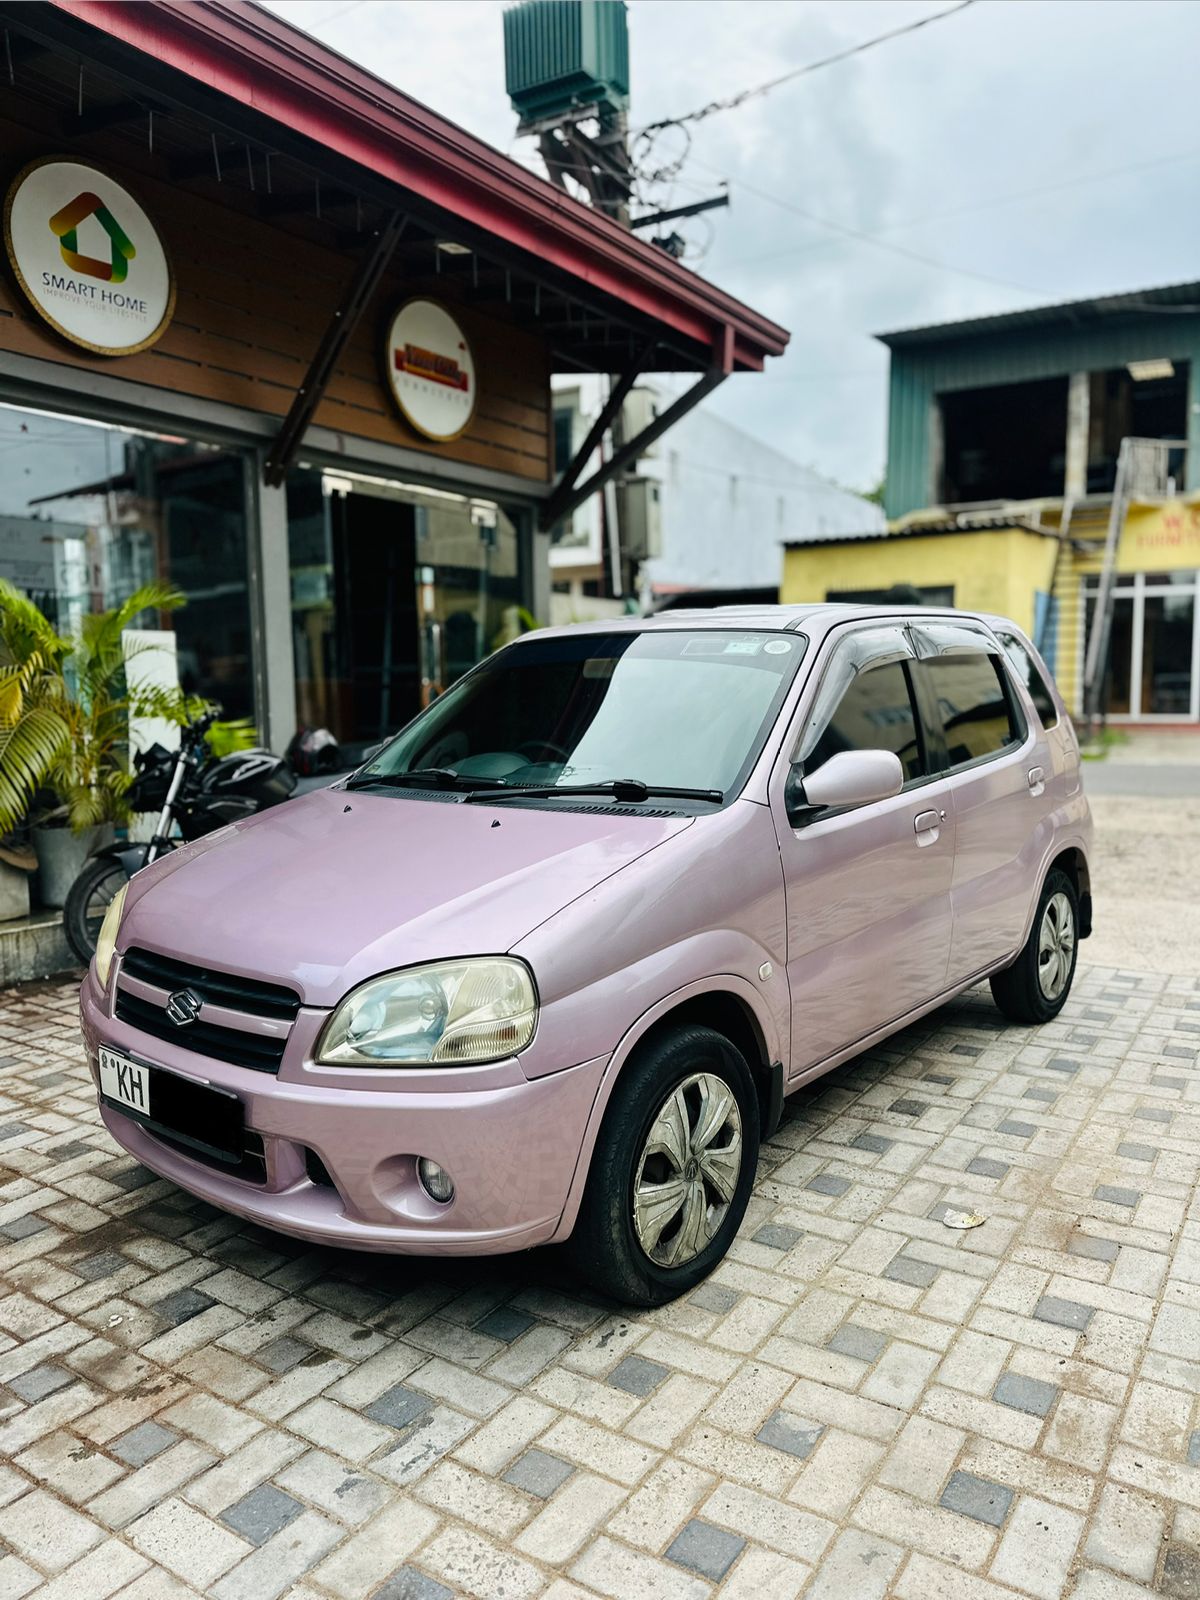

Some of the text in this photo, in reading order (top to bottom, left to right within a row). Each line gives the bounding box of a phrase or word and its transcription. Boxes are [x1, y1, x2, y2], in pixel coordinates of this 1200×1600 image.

[42, 272, 148, 314] SMART HOME
[116, 1060, 144, 1107] KH
